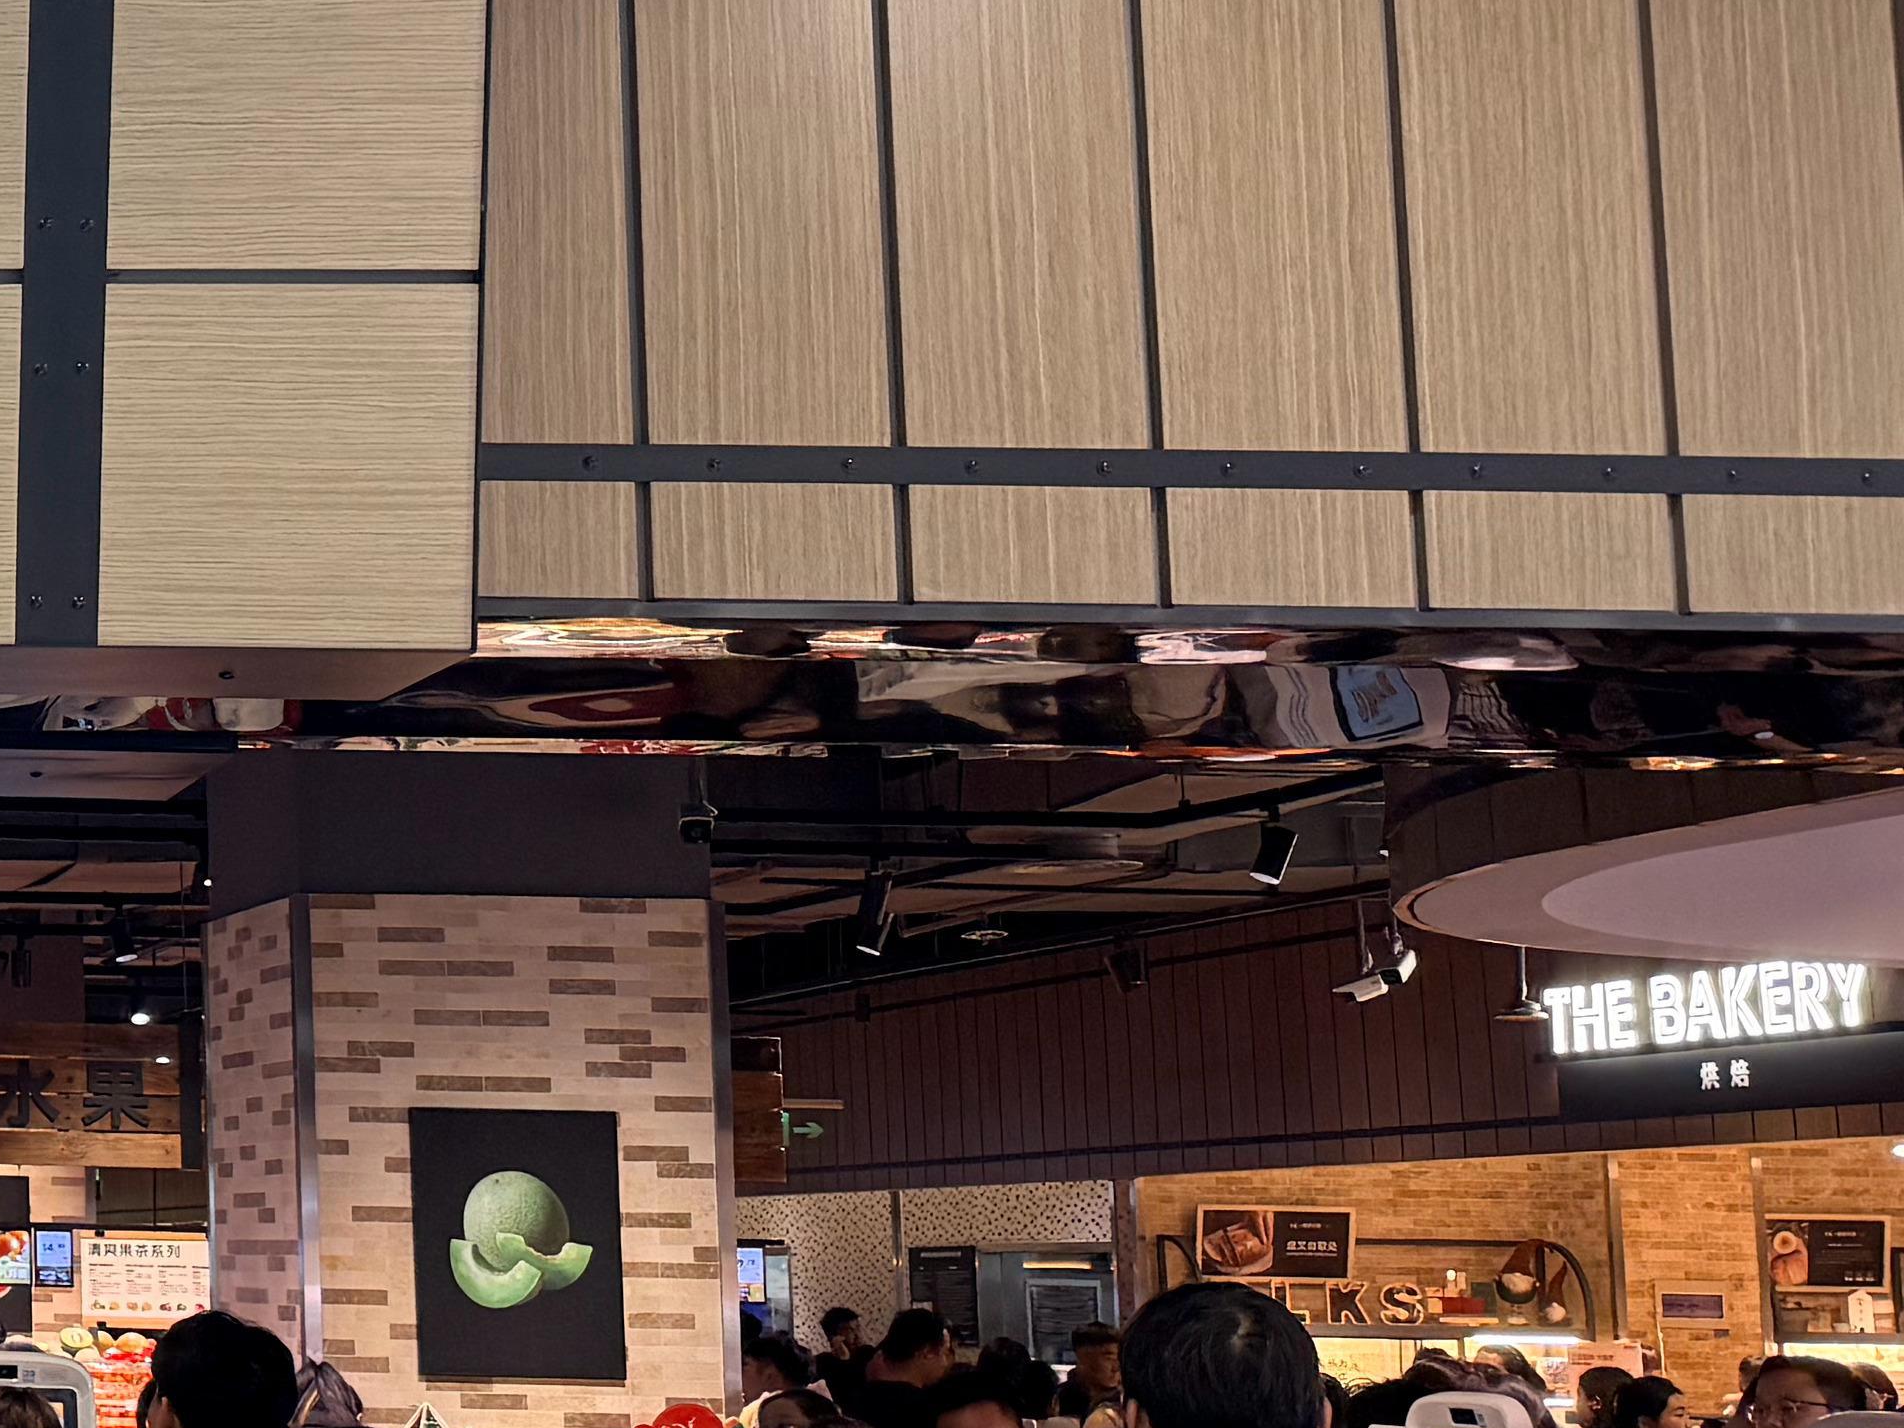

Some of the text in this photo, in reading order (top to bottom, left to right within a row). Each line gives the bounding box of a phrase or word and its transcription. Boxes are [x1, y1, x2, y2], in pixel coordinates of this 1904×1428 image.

[1543, 960, 1865, 1056] THE BAKERY
[1270, 1280, 1424, 1326] LKS
